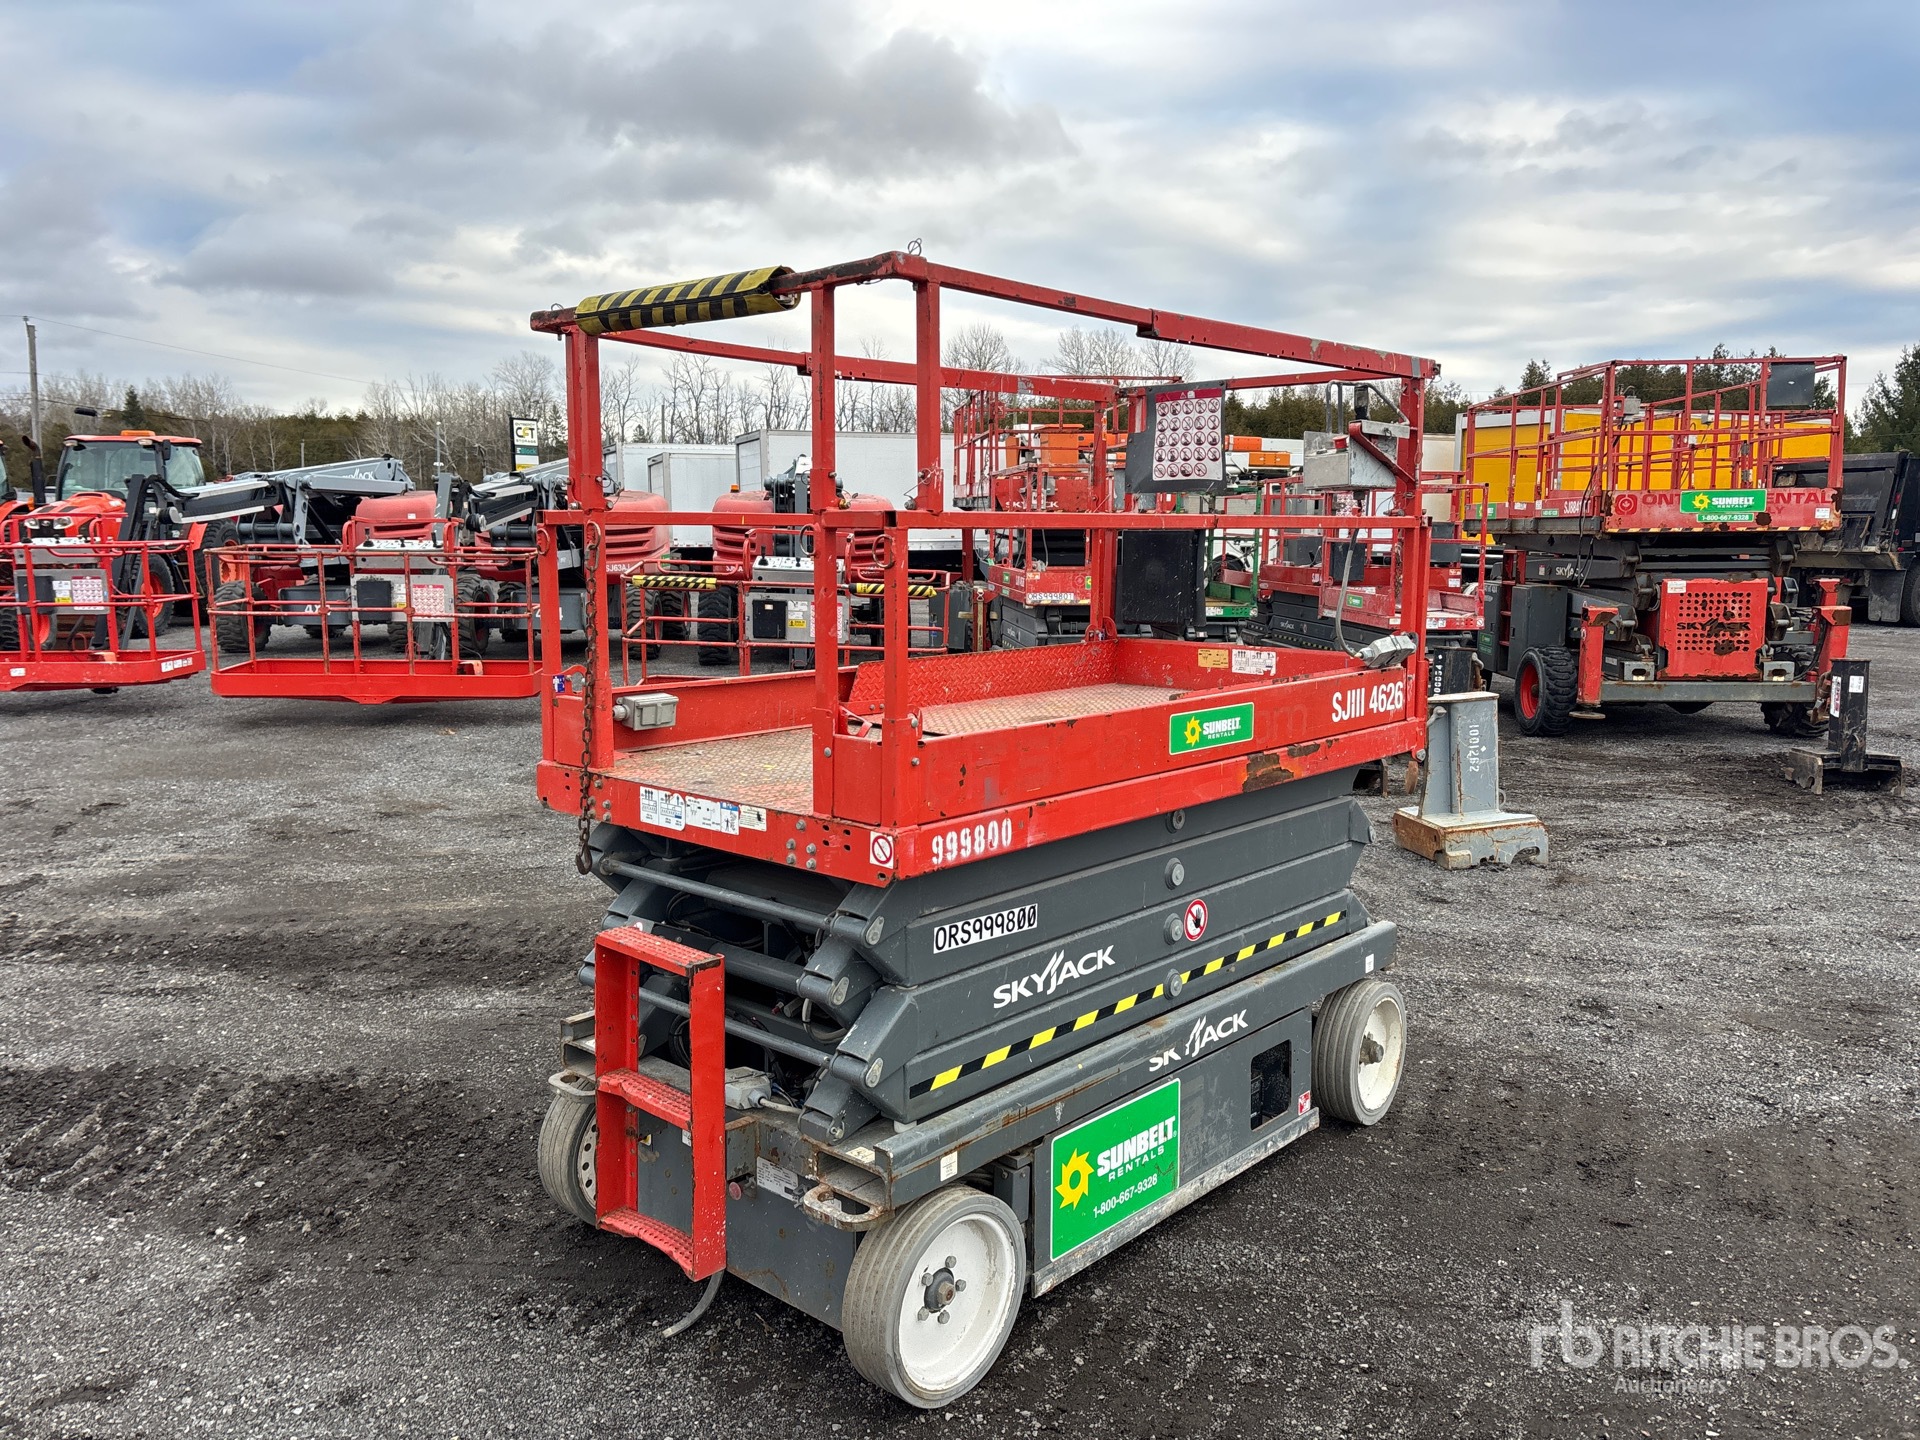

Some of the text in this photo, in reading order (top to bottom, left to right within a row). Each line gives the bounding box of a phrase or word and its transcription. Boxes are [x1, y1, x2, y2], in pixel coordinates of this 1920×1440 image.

[1712, 497, 1755, 505] SUNBELT
[1766, 492, 1833, 505] ENTAL
[1331, 681, 1403, 723] SJIII 4626
[1202, 716, 1241, 735] SUNBELT
[1207, 731, 1235, 740] RENTALS
[931, 817, 1013, 865] 999800
[993, 945, 1116, 1009] SKYJACK
[1096, 1115, 1177, 1178] SUNBELT
[1108, 1145, 1165, 1182] RENTALS
[1092, 1172, 1159, 1219] 1-800-667-9328
